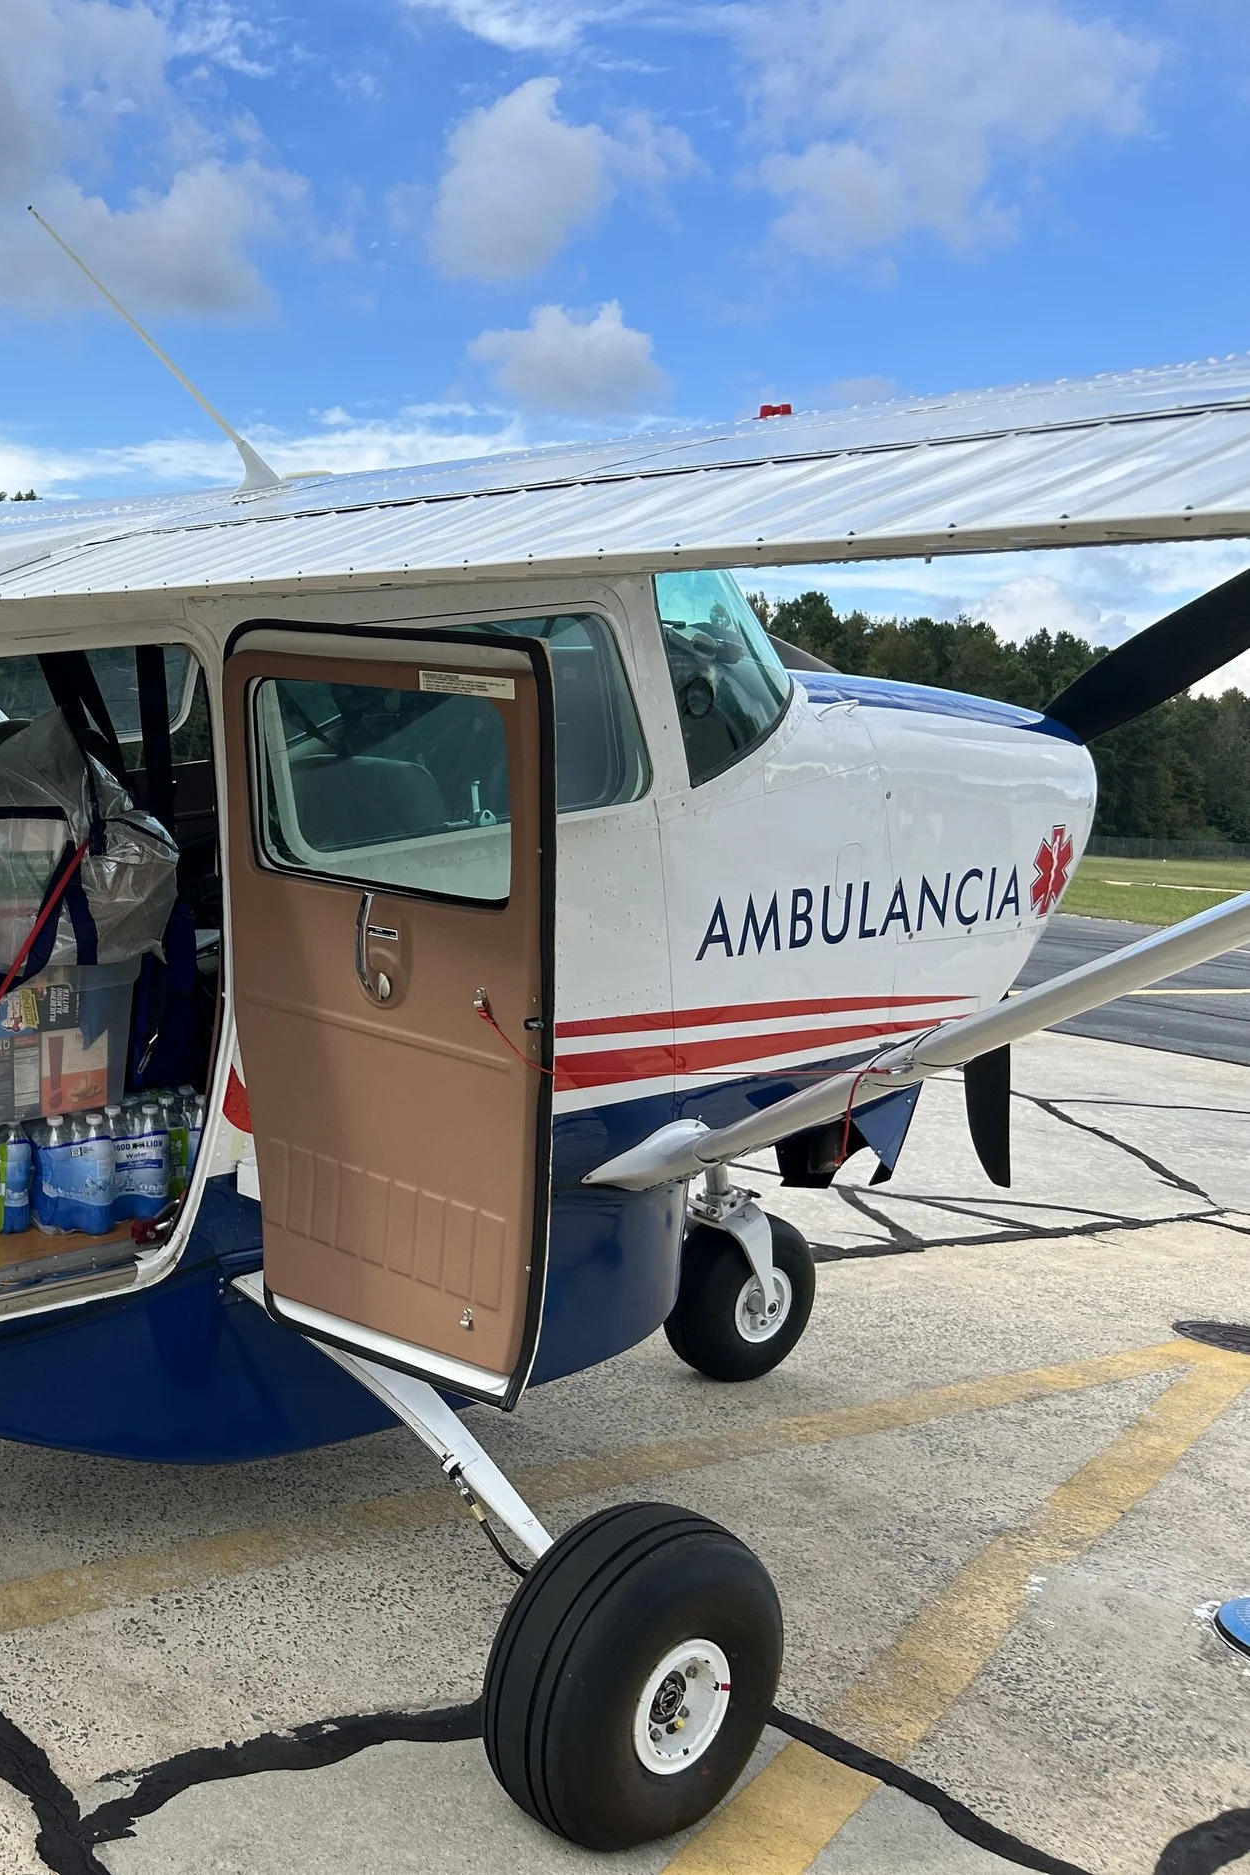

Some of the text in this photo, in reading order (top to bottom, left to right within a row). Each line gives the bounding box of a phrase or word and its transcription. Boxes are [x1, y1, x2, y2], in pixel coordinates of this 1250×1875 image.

[695, 864, 1020, 961] AMBULANCIA
[146, 1140, 163, 1148] LION
[126, 1151, 147, 1159] Water
